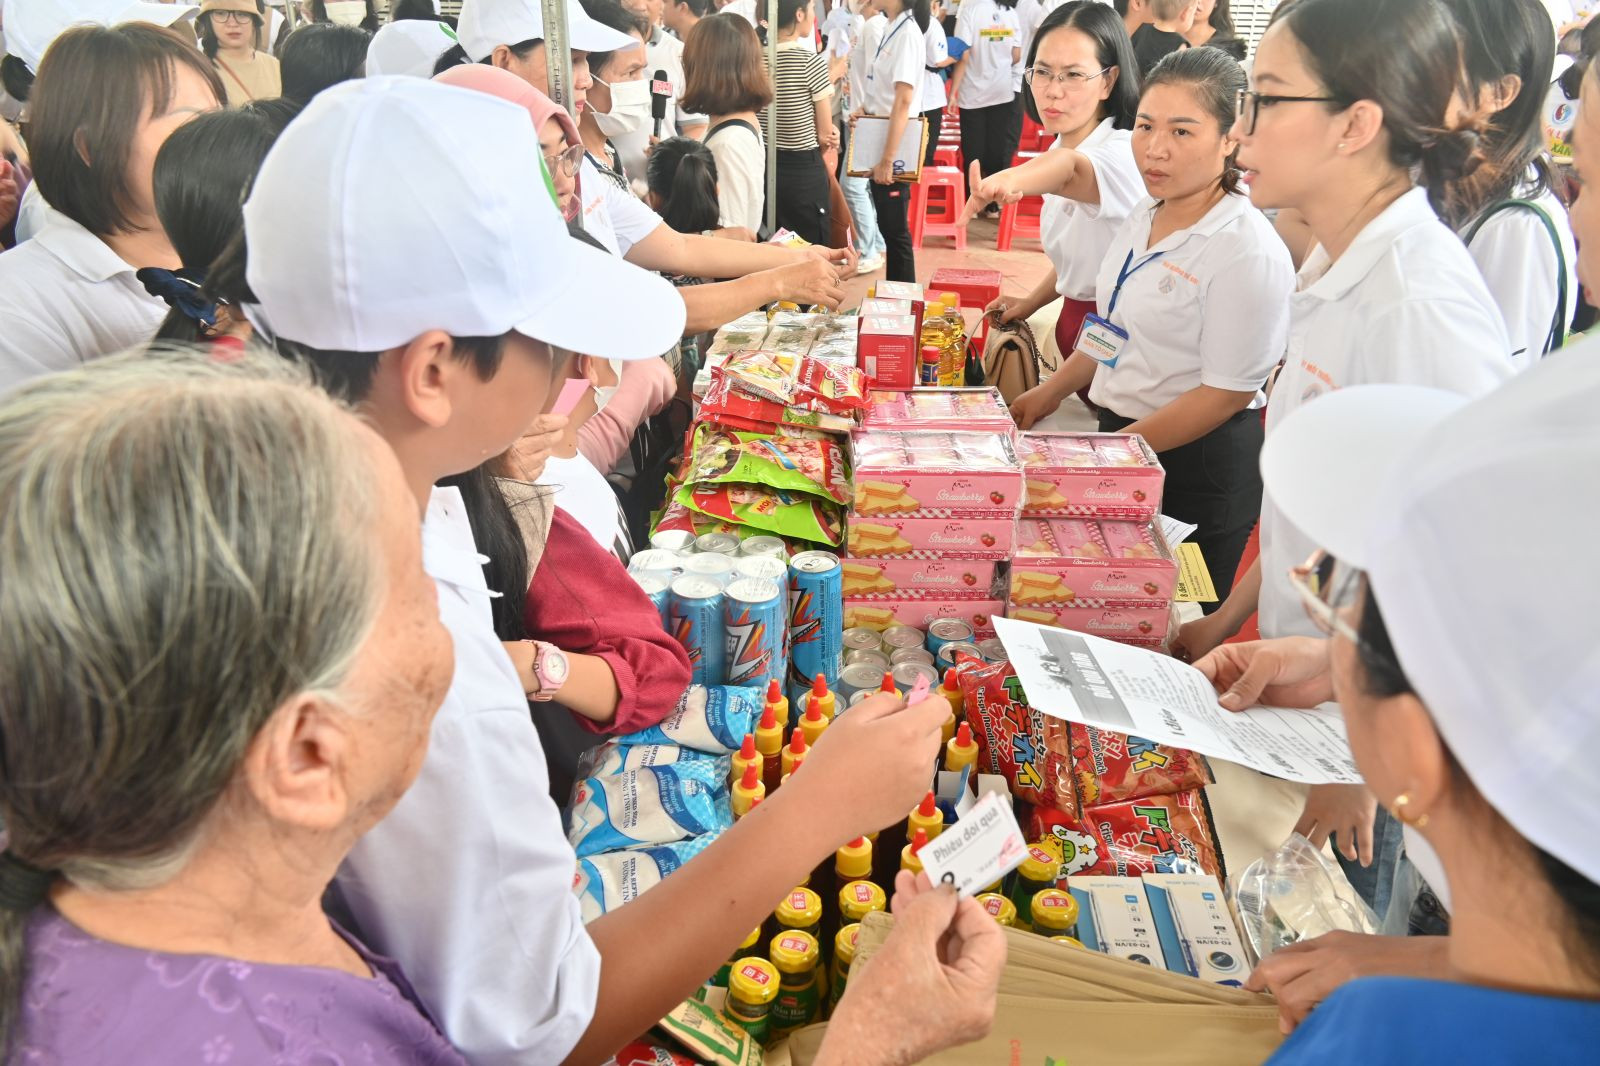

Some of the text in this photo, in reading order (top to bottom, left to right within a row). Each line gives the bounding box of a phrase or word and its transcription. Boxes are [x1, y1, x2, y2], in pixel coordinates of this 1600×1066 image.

[935, 489, 985, 503] Strawberry
[1083, 488, 1129, 501] Strawberry
[928, 531, 977, 545] Strawberry
[911, 572, 959, 585] Strawberry
[1090, 580, 1140, 593] Strawberry
[1086, 619, 1135, 631] Strawberry
[1093, 751, 1107, 775] Snack
